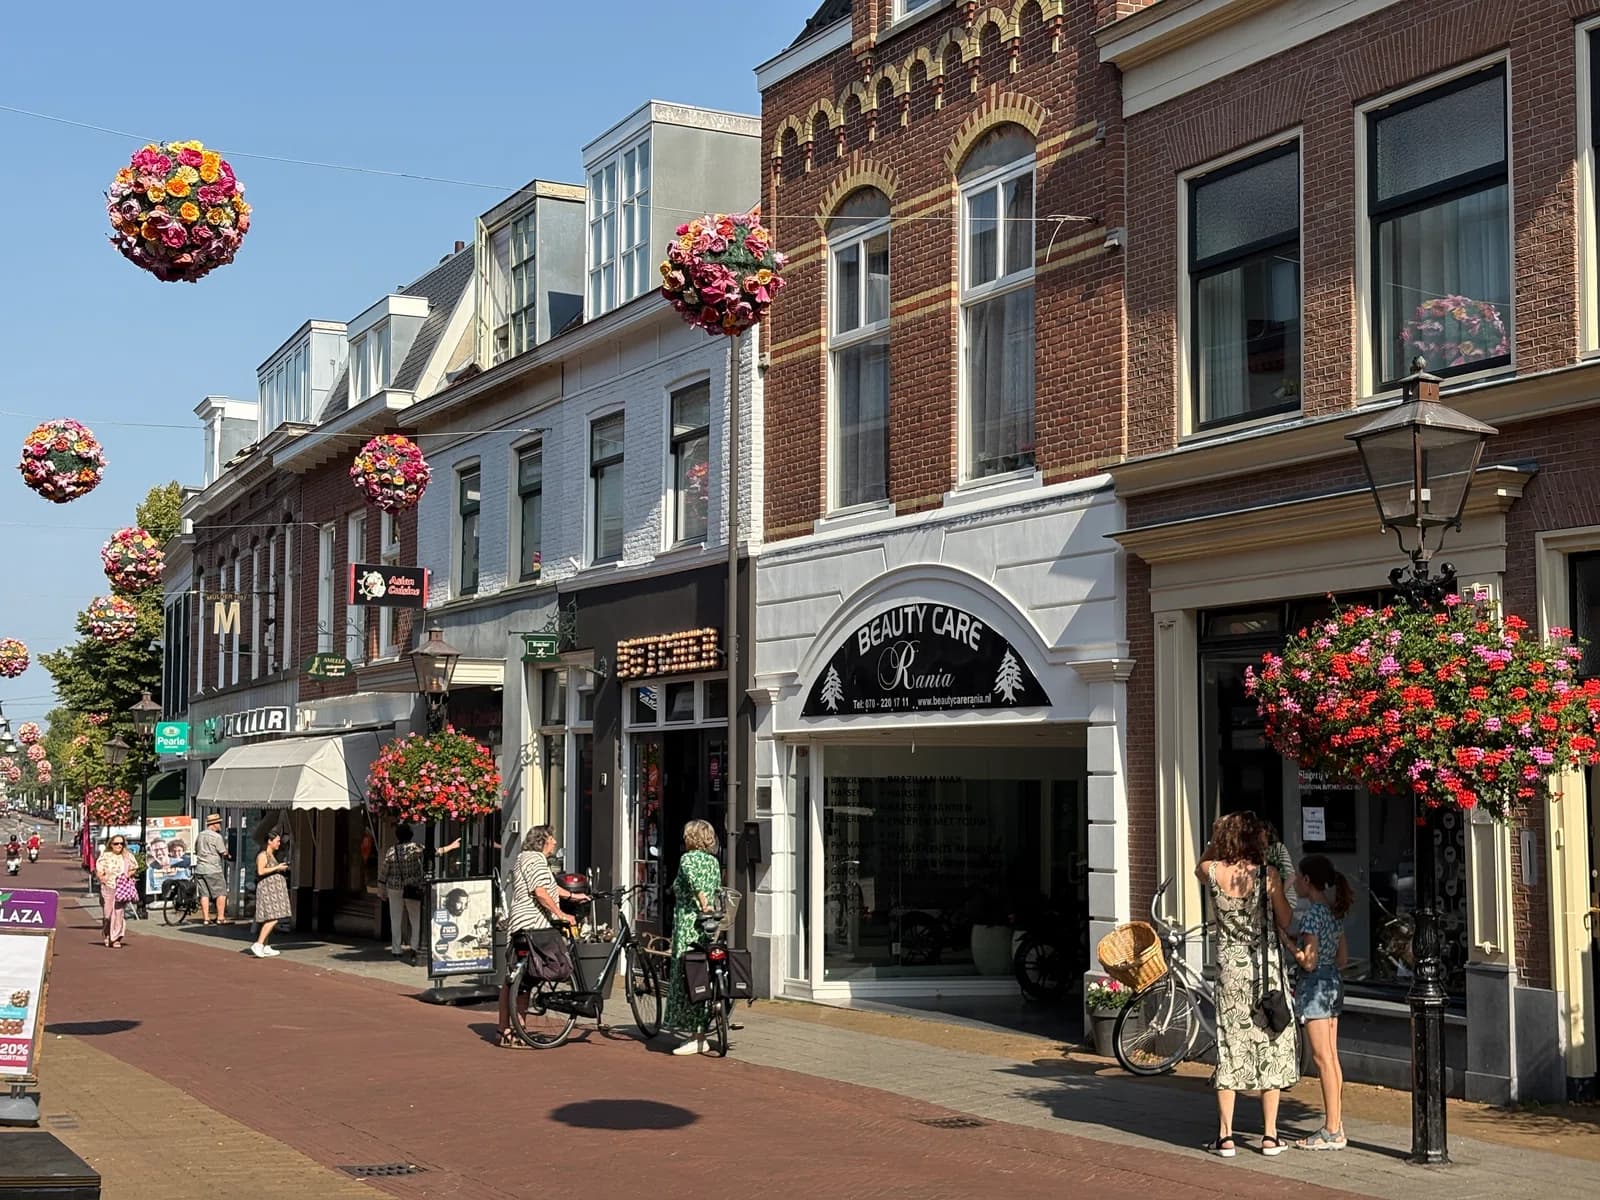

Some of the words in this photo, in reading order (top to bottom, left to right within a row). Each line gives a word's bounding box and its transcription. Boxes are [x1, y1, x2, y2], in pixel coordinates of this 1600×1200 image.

[389, 576, 415, 586] Asian
[388, 586, 420, 596] Cuisine
[213, 602, 241, 634] M
[857, 603, 928, 657] BEAUTY
[932, 606, 983, 652] CARE
[877, 640, 956, 691] Rania
[865, 698, 876, 709] 070
[880, 697, 892, 709] 220
[893, 697, 901, 708] 17
[902, 697, 909, 708] 11
[917, 693, 992, 707] www.beautycarerania.nl
[157, 736, 186, 746] Pearle
[887, 775, 937, 784] BRAZILIAN
[938, 775, 961, 784] WAX
[0, 1043, 29, 1056] 20%
